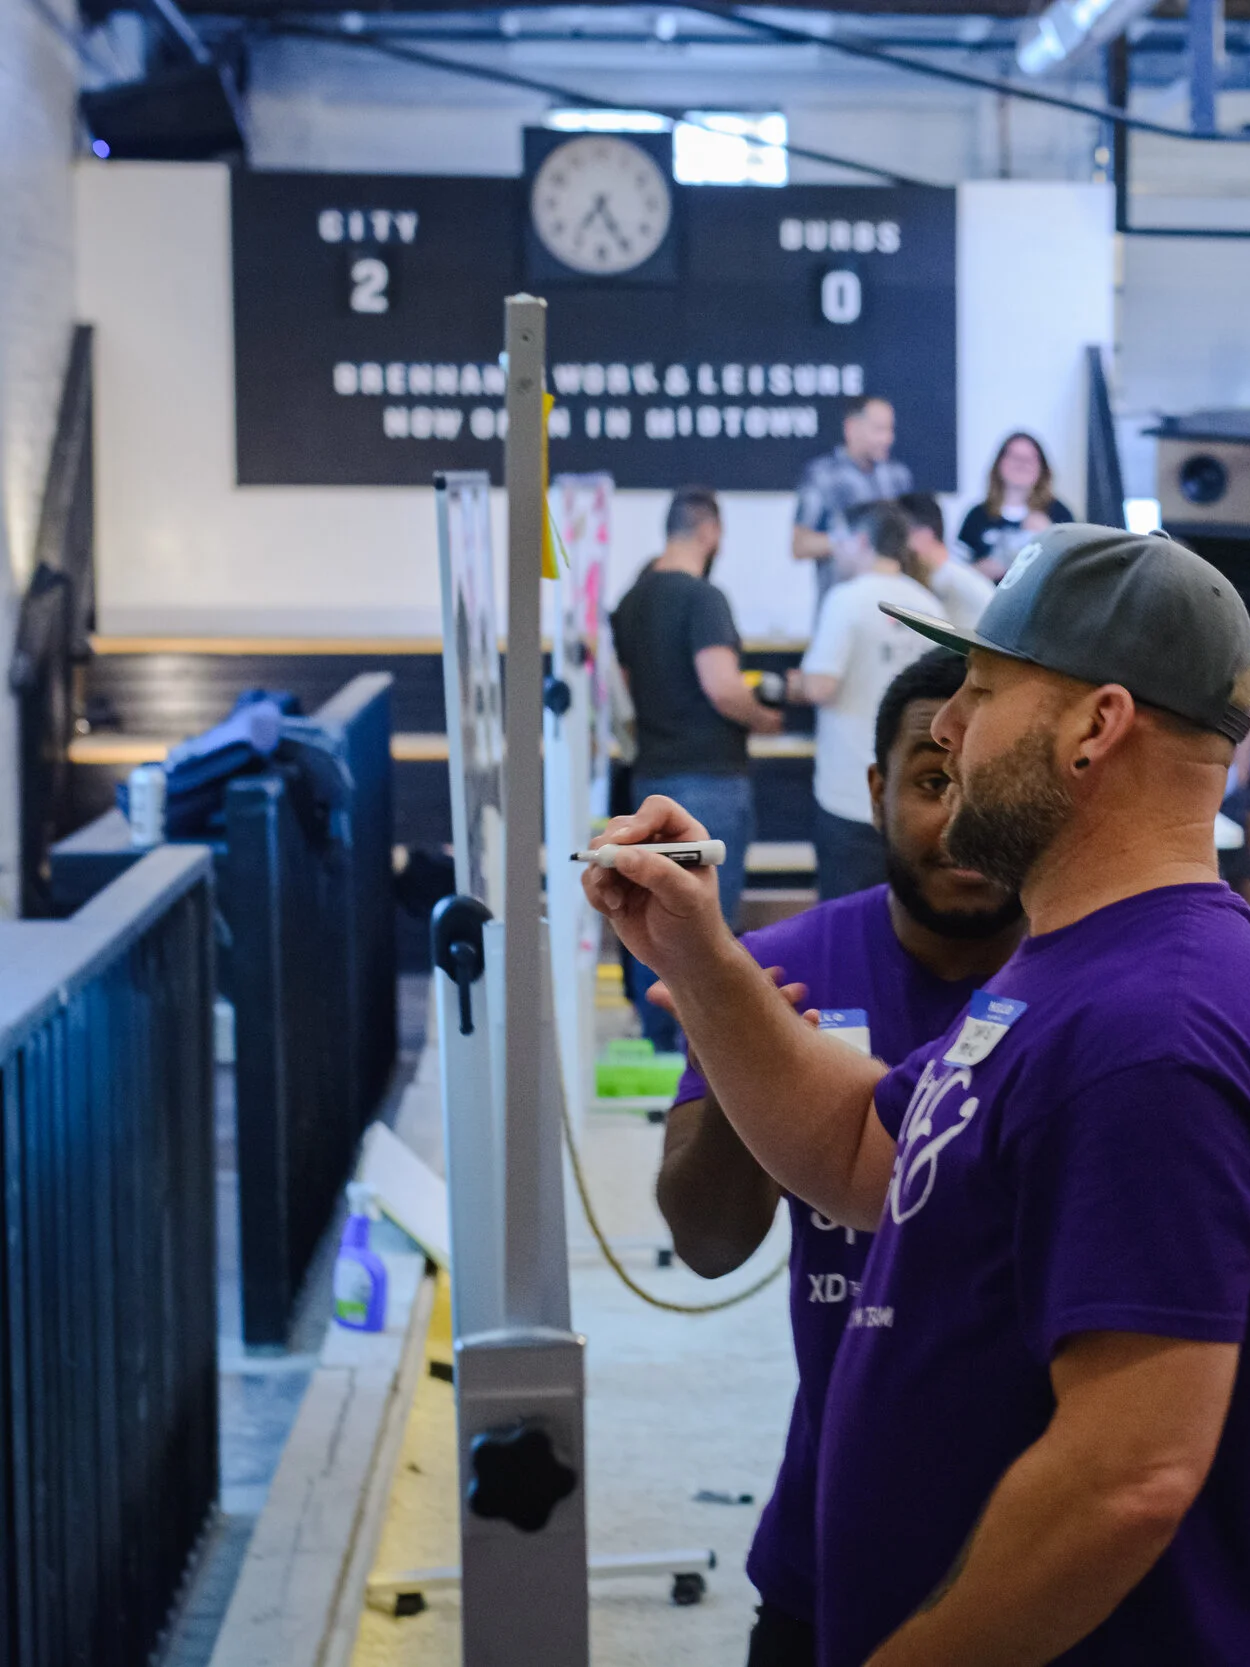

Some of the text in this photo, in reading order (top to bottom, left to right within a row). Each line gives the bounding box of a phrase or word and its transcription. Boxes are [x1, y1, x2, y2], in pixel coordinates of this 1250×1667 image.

[318, 209, 419, 244] CITY
[350, 257, 390, 314] 2
[697, 362, 865, 397] LEISURE
[382, 405, 819, 441] NOW ON IN MIDTOWN
